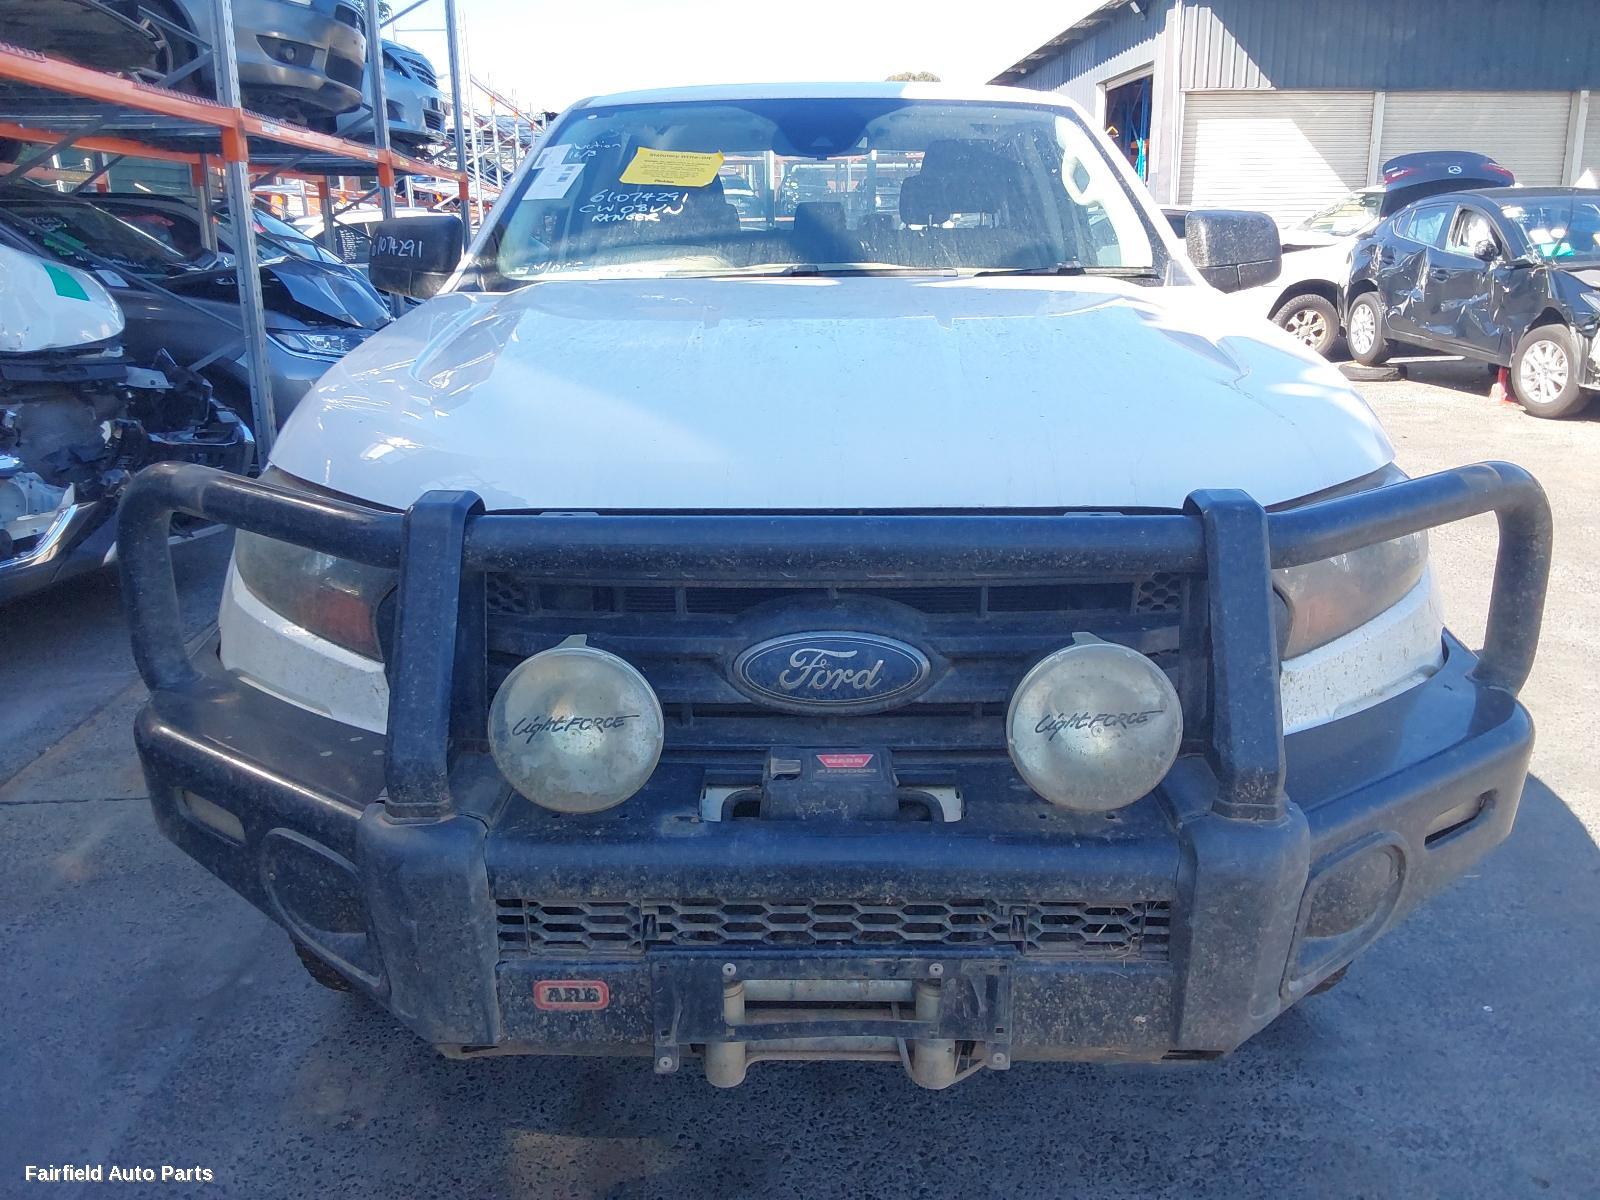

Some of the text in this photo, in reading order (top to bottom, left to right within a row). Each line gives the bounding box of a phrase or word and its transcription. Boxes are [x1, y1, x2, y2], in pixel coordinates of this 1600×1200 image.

[590, 189, 689, 203] 61074291
[591, 213, 661, 222] RANGER
[779, 648, 884, 690] Ford
